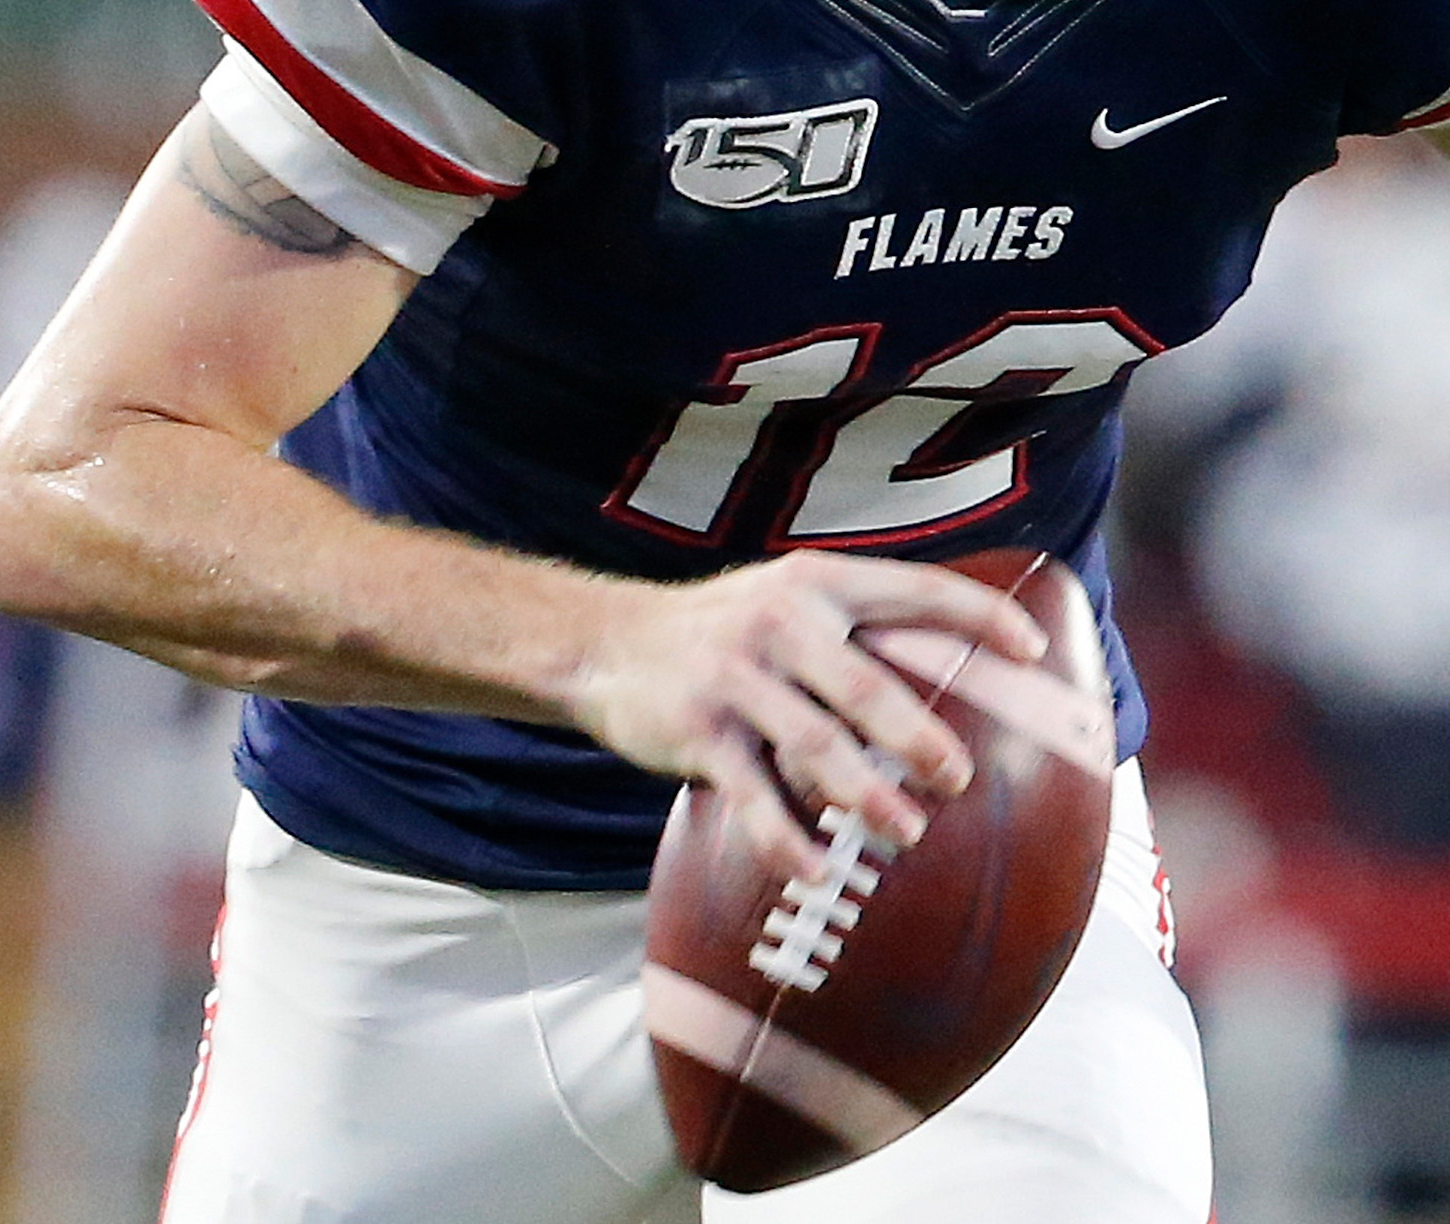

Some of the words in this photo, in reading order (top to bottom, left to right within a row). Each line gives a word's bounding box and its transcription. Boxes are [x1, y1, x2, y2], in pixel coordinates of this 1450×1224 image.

[665, 98, 878, 209] 150
[834, 206, 1073, 279] FLAMES
[599, 306, 1165, 551] 12
